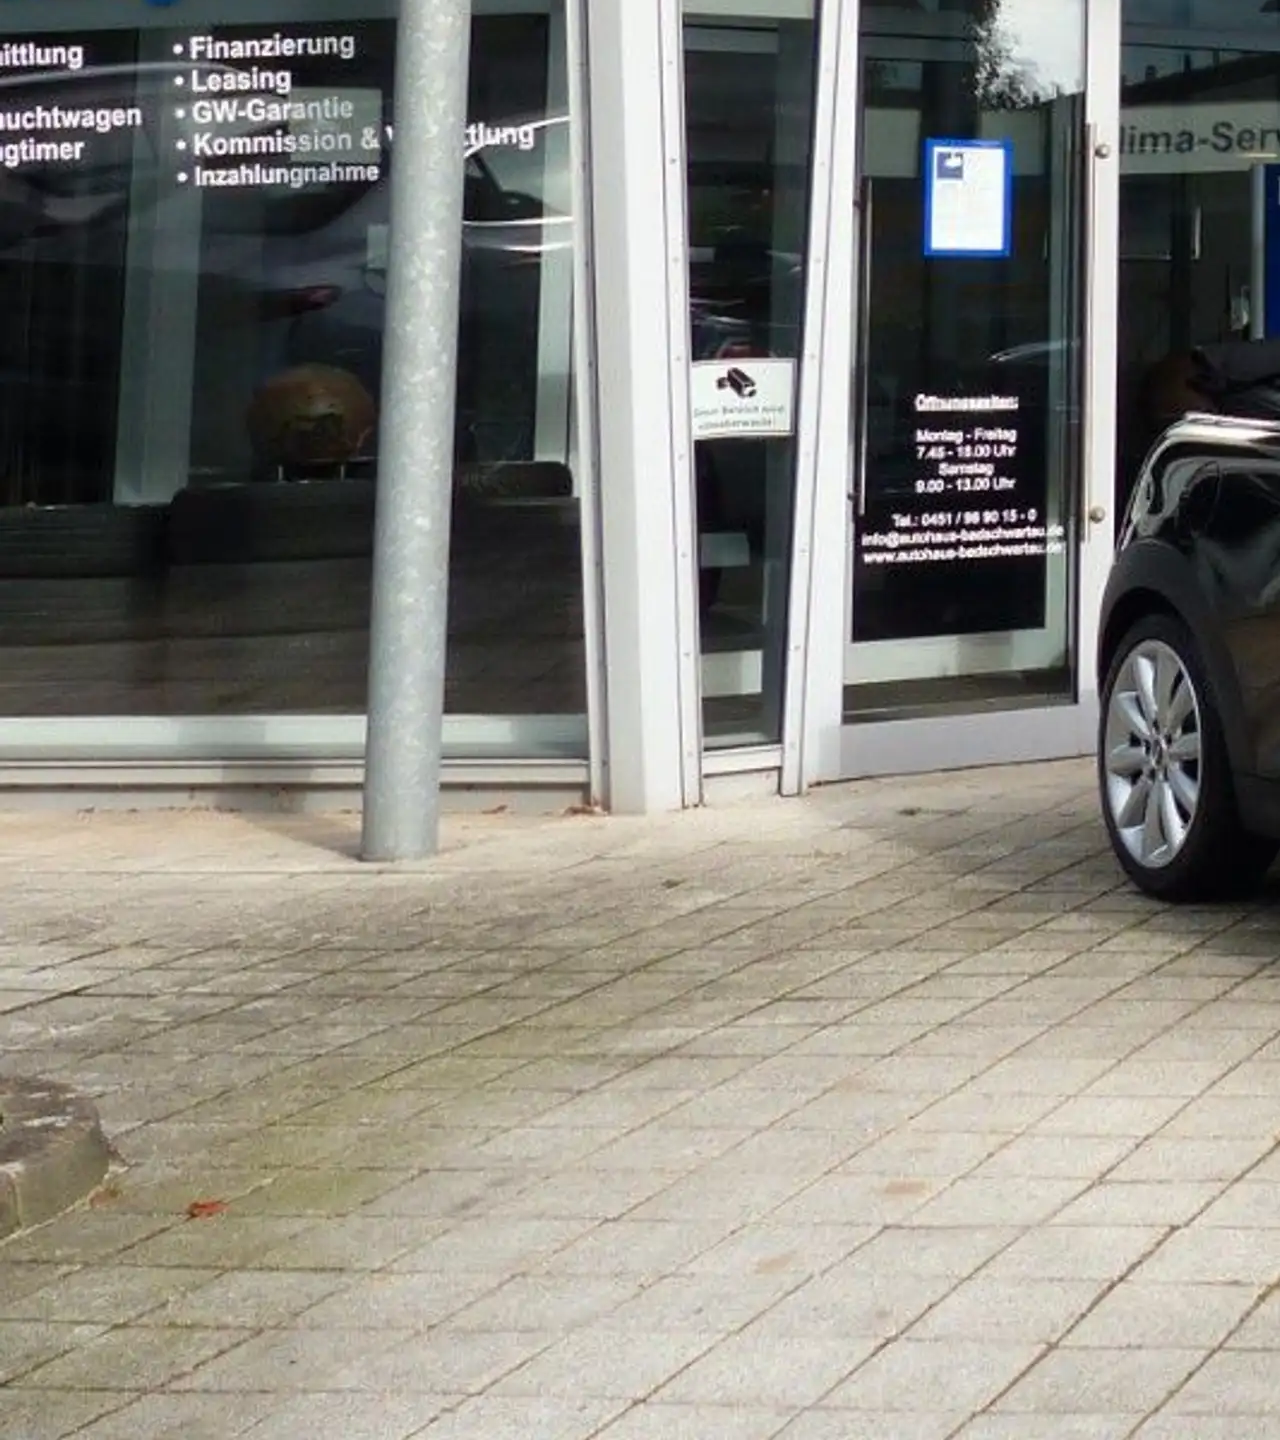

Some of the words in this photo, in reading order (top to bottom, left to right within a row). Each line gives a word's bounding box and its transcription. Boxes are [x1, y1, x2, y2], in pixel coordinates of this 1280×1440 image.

[190, 34, 355, 61] Finanzierung
[191, 68, 292, 95] Leasing
[192, 97, 354, 124] GW-Garantie
[193, 127, 352, 157] Kommission
[361, 126, 381, 150] &
[195, 161, 380, 188] Inzahlungnahme
[974, 427, 1018, 443] Freitag
[993, 443, 1017, 458] Uhr
[993, 477, 1017, 491] Uhr
